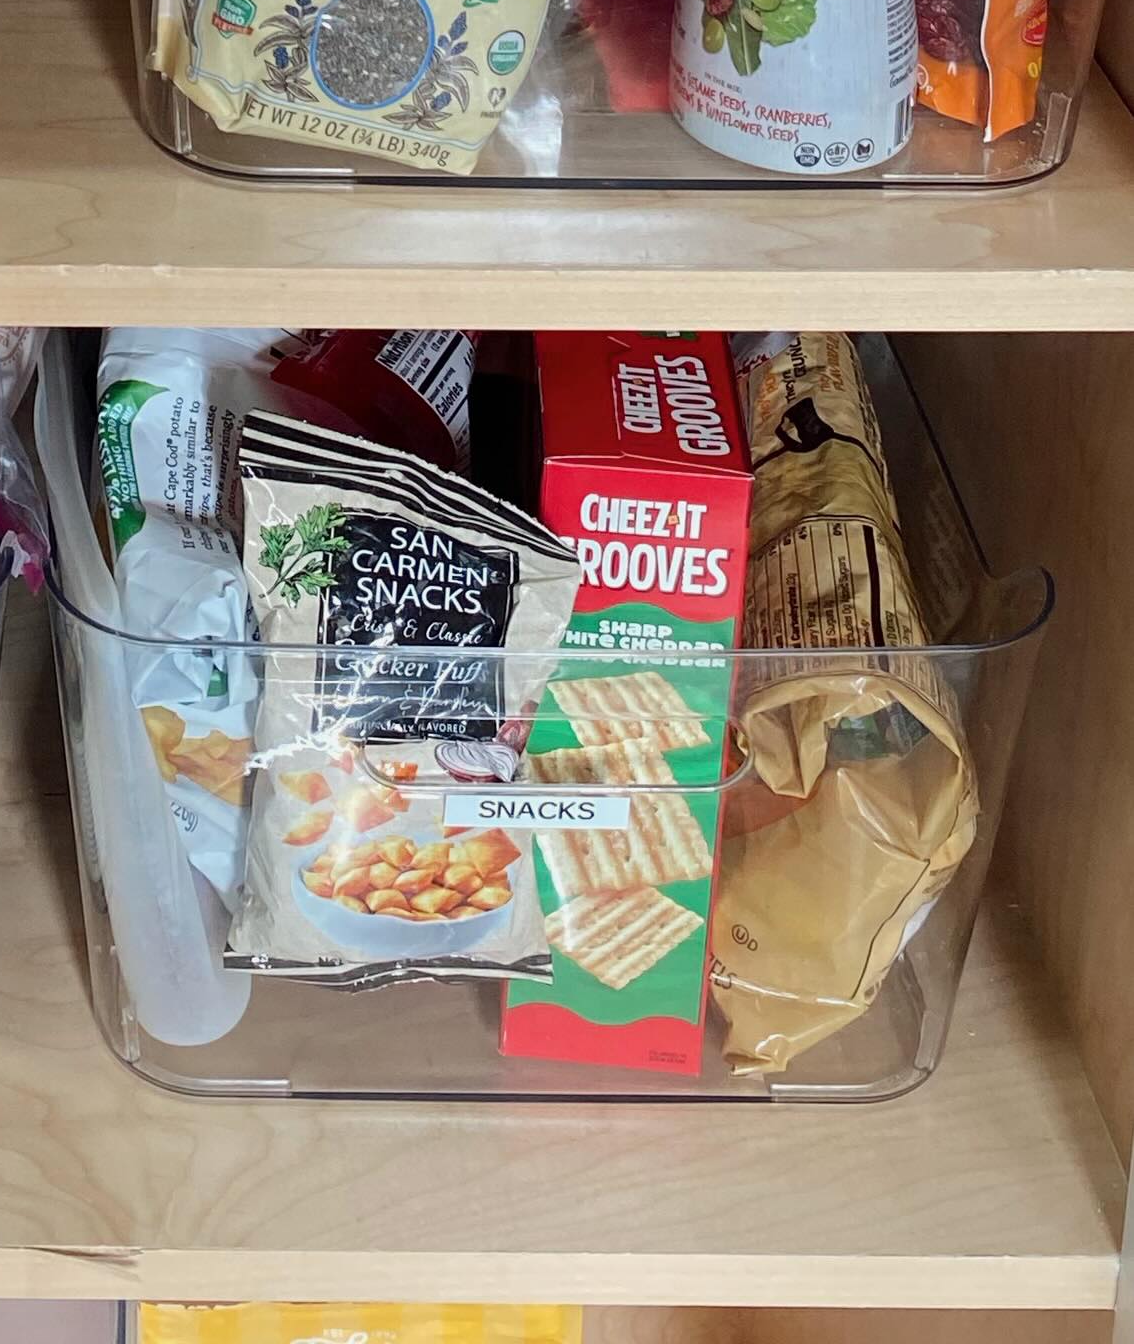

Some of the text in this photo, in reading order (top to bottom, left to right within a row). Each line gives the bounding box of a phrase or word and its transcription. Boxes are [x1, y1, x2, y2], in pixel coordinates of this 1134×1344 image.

[688, 73, 832, 129] SESAME SEEDS, CRANBERRIES,
[706, 101, 800, 144] SUNFLOWER SEEDS
[272, 107, 451, 166] WT 12 OZ LB) 340g
[435, 383, 463, 417] Calories
[654, 354, 731, 457] GROOVES
[107, 402, 130, 503] NOTHING ADDED
[163, 396, 184, 501] Cape potato
[184, 400, 200, 460] similar to
[200, 405, 217, 487] that's because
[219, 408, 235, 480] surprisingly
[353, 550, 490, 588] CARMEN
[391, 527, 453, 561] SAN
[355, 576, 483, 614] SNACKS
[403, 619, 483, 646] & Classic
[478, 800, 596, 822] SNACKS
